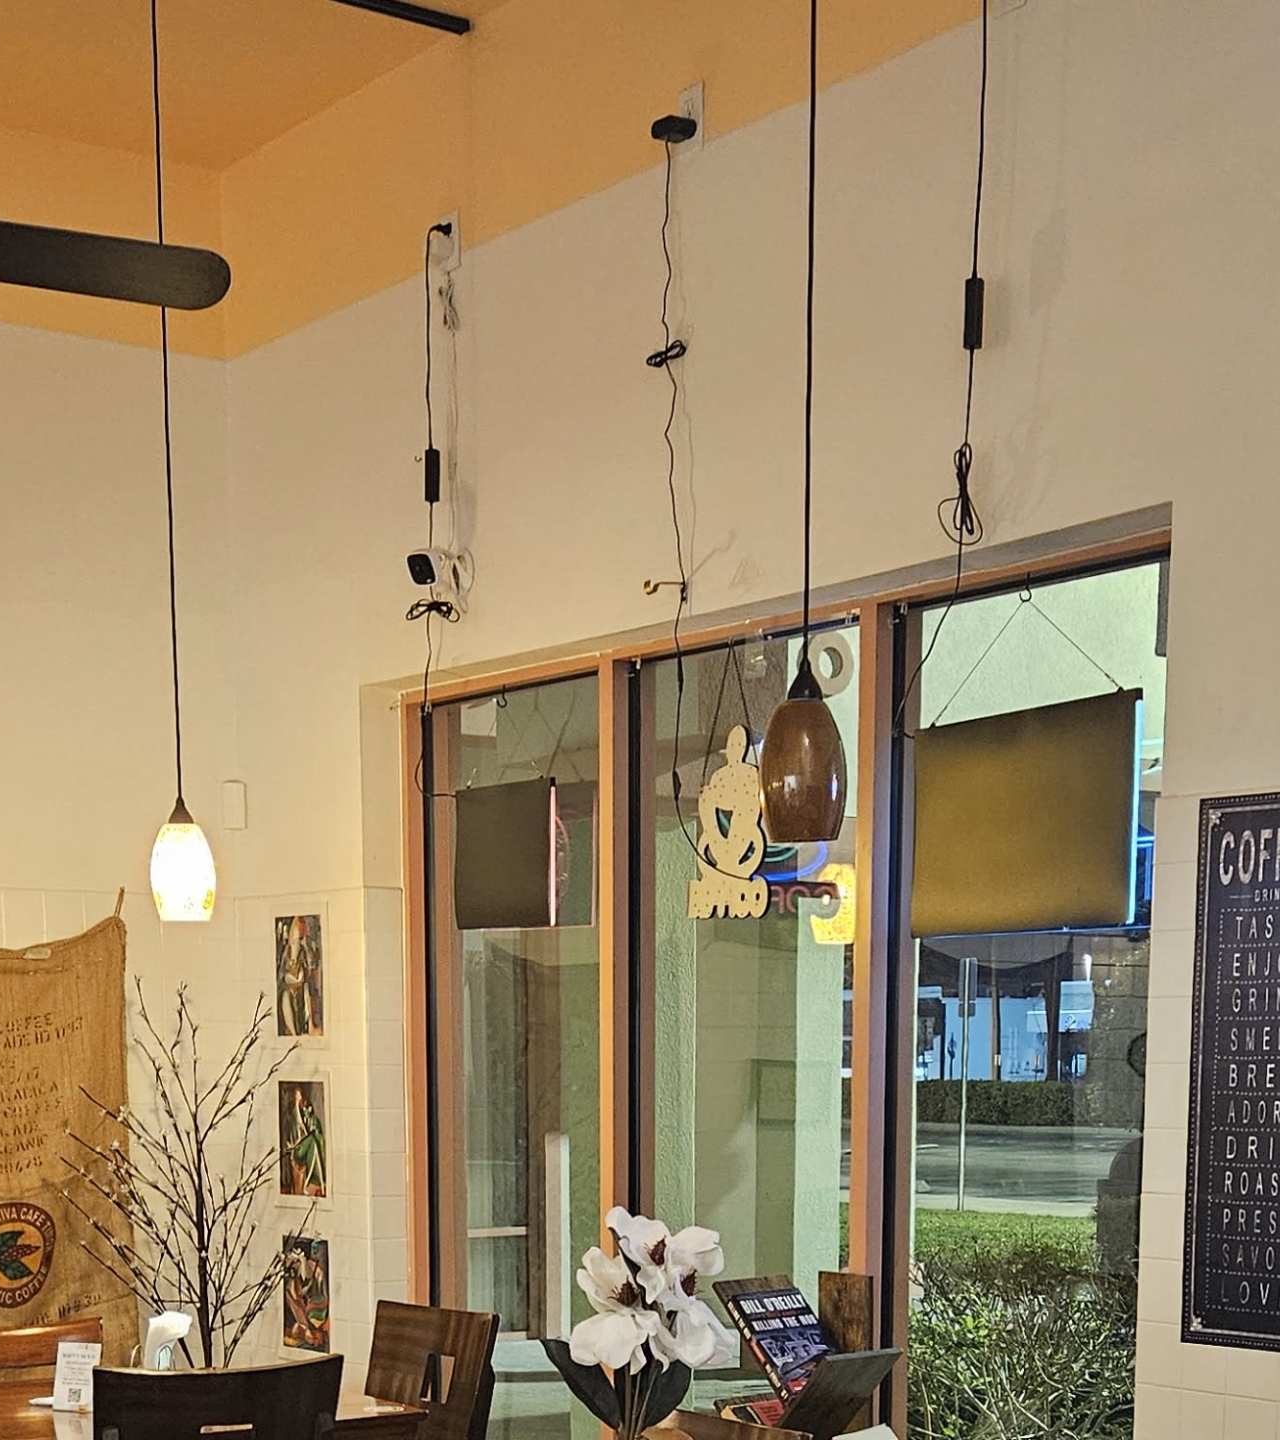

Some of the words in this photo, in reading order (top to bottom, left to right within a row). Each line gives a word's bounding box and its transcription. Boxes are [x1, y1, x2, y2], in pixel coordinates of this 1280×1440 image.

[19, 1206, 43, 1227] CAFE
[740, 1298, 766, 1314] BILL
[763, 1294, 806, 1312] O'REILLY
[752, 1318, 784, 1331] KILLING
[782, 1316, 800, 1328] THE
